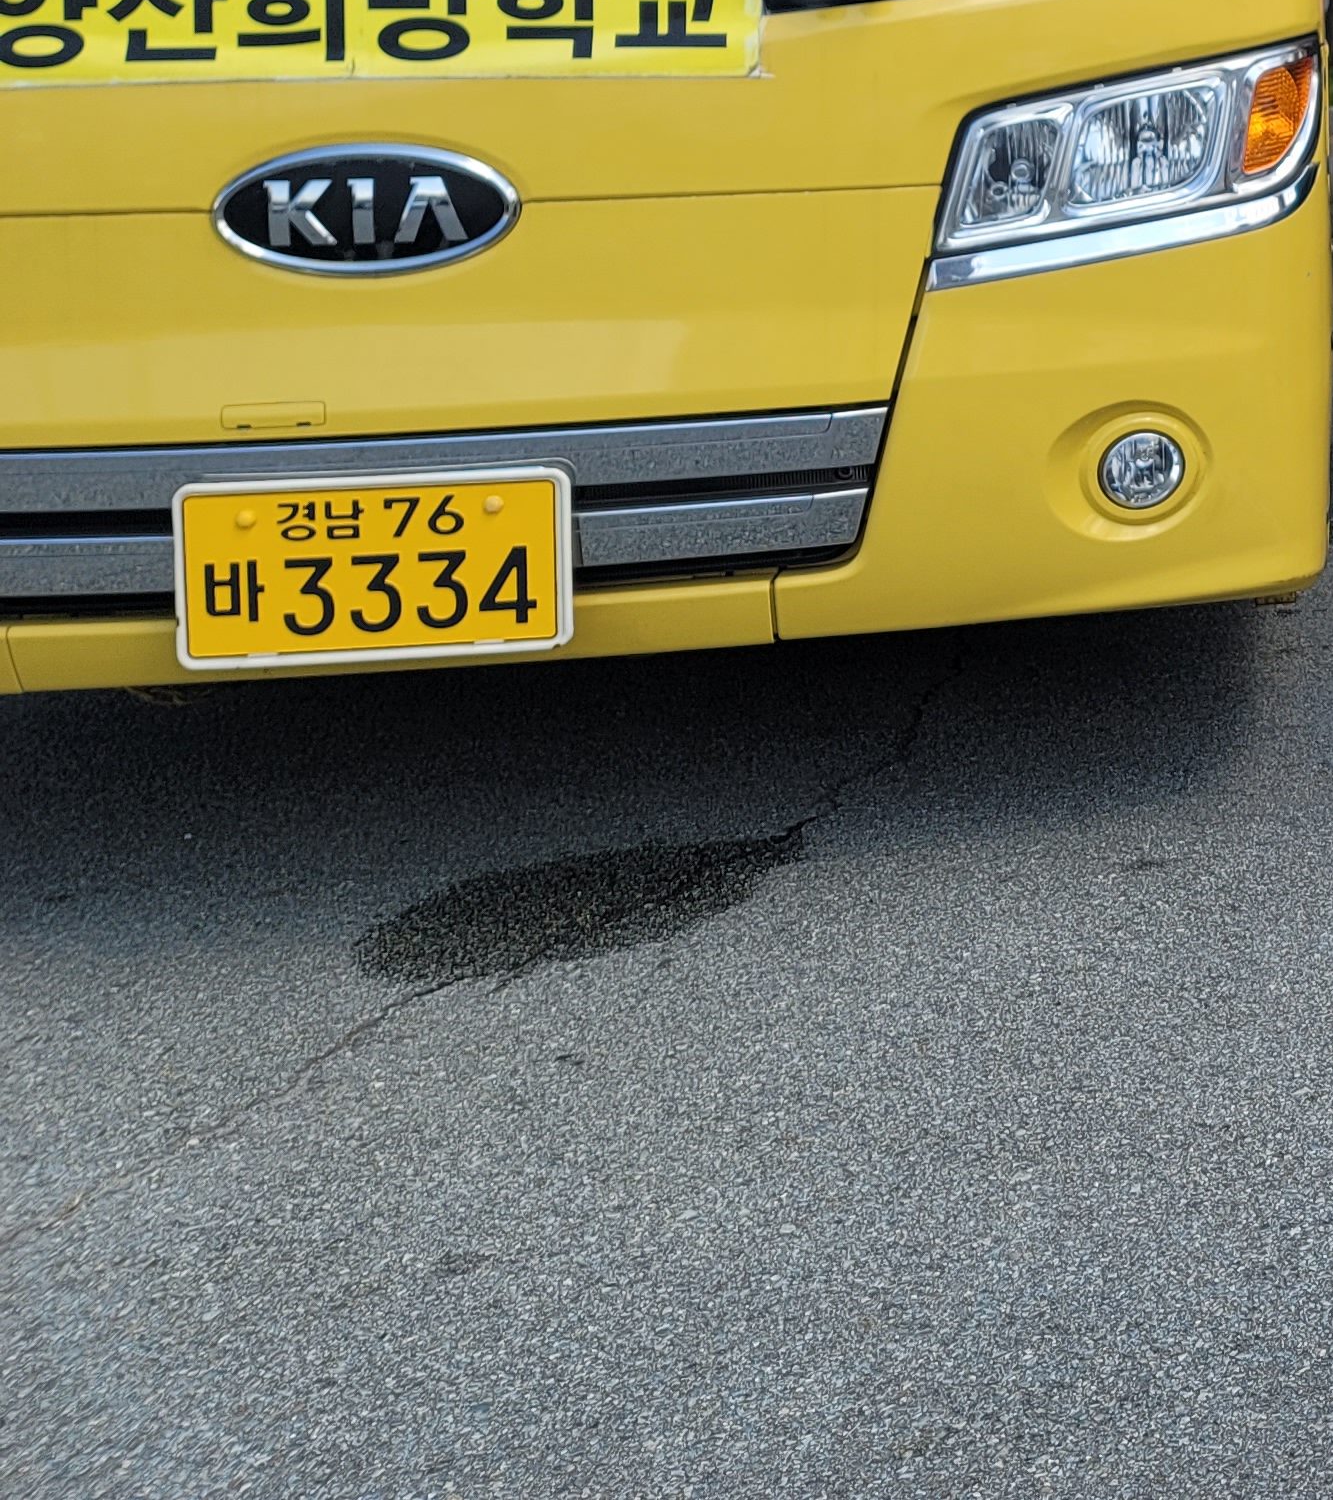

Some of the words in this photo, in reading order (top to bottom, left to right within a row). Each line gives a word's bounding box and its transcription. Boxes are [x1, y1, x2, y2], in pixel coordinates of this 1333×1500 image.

[263, 175, 469, 246] KIA
[276, 499, 364, 541] 경남
[383, 494, 464, 538] 76
